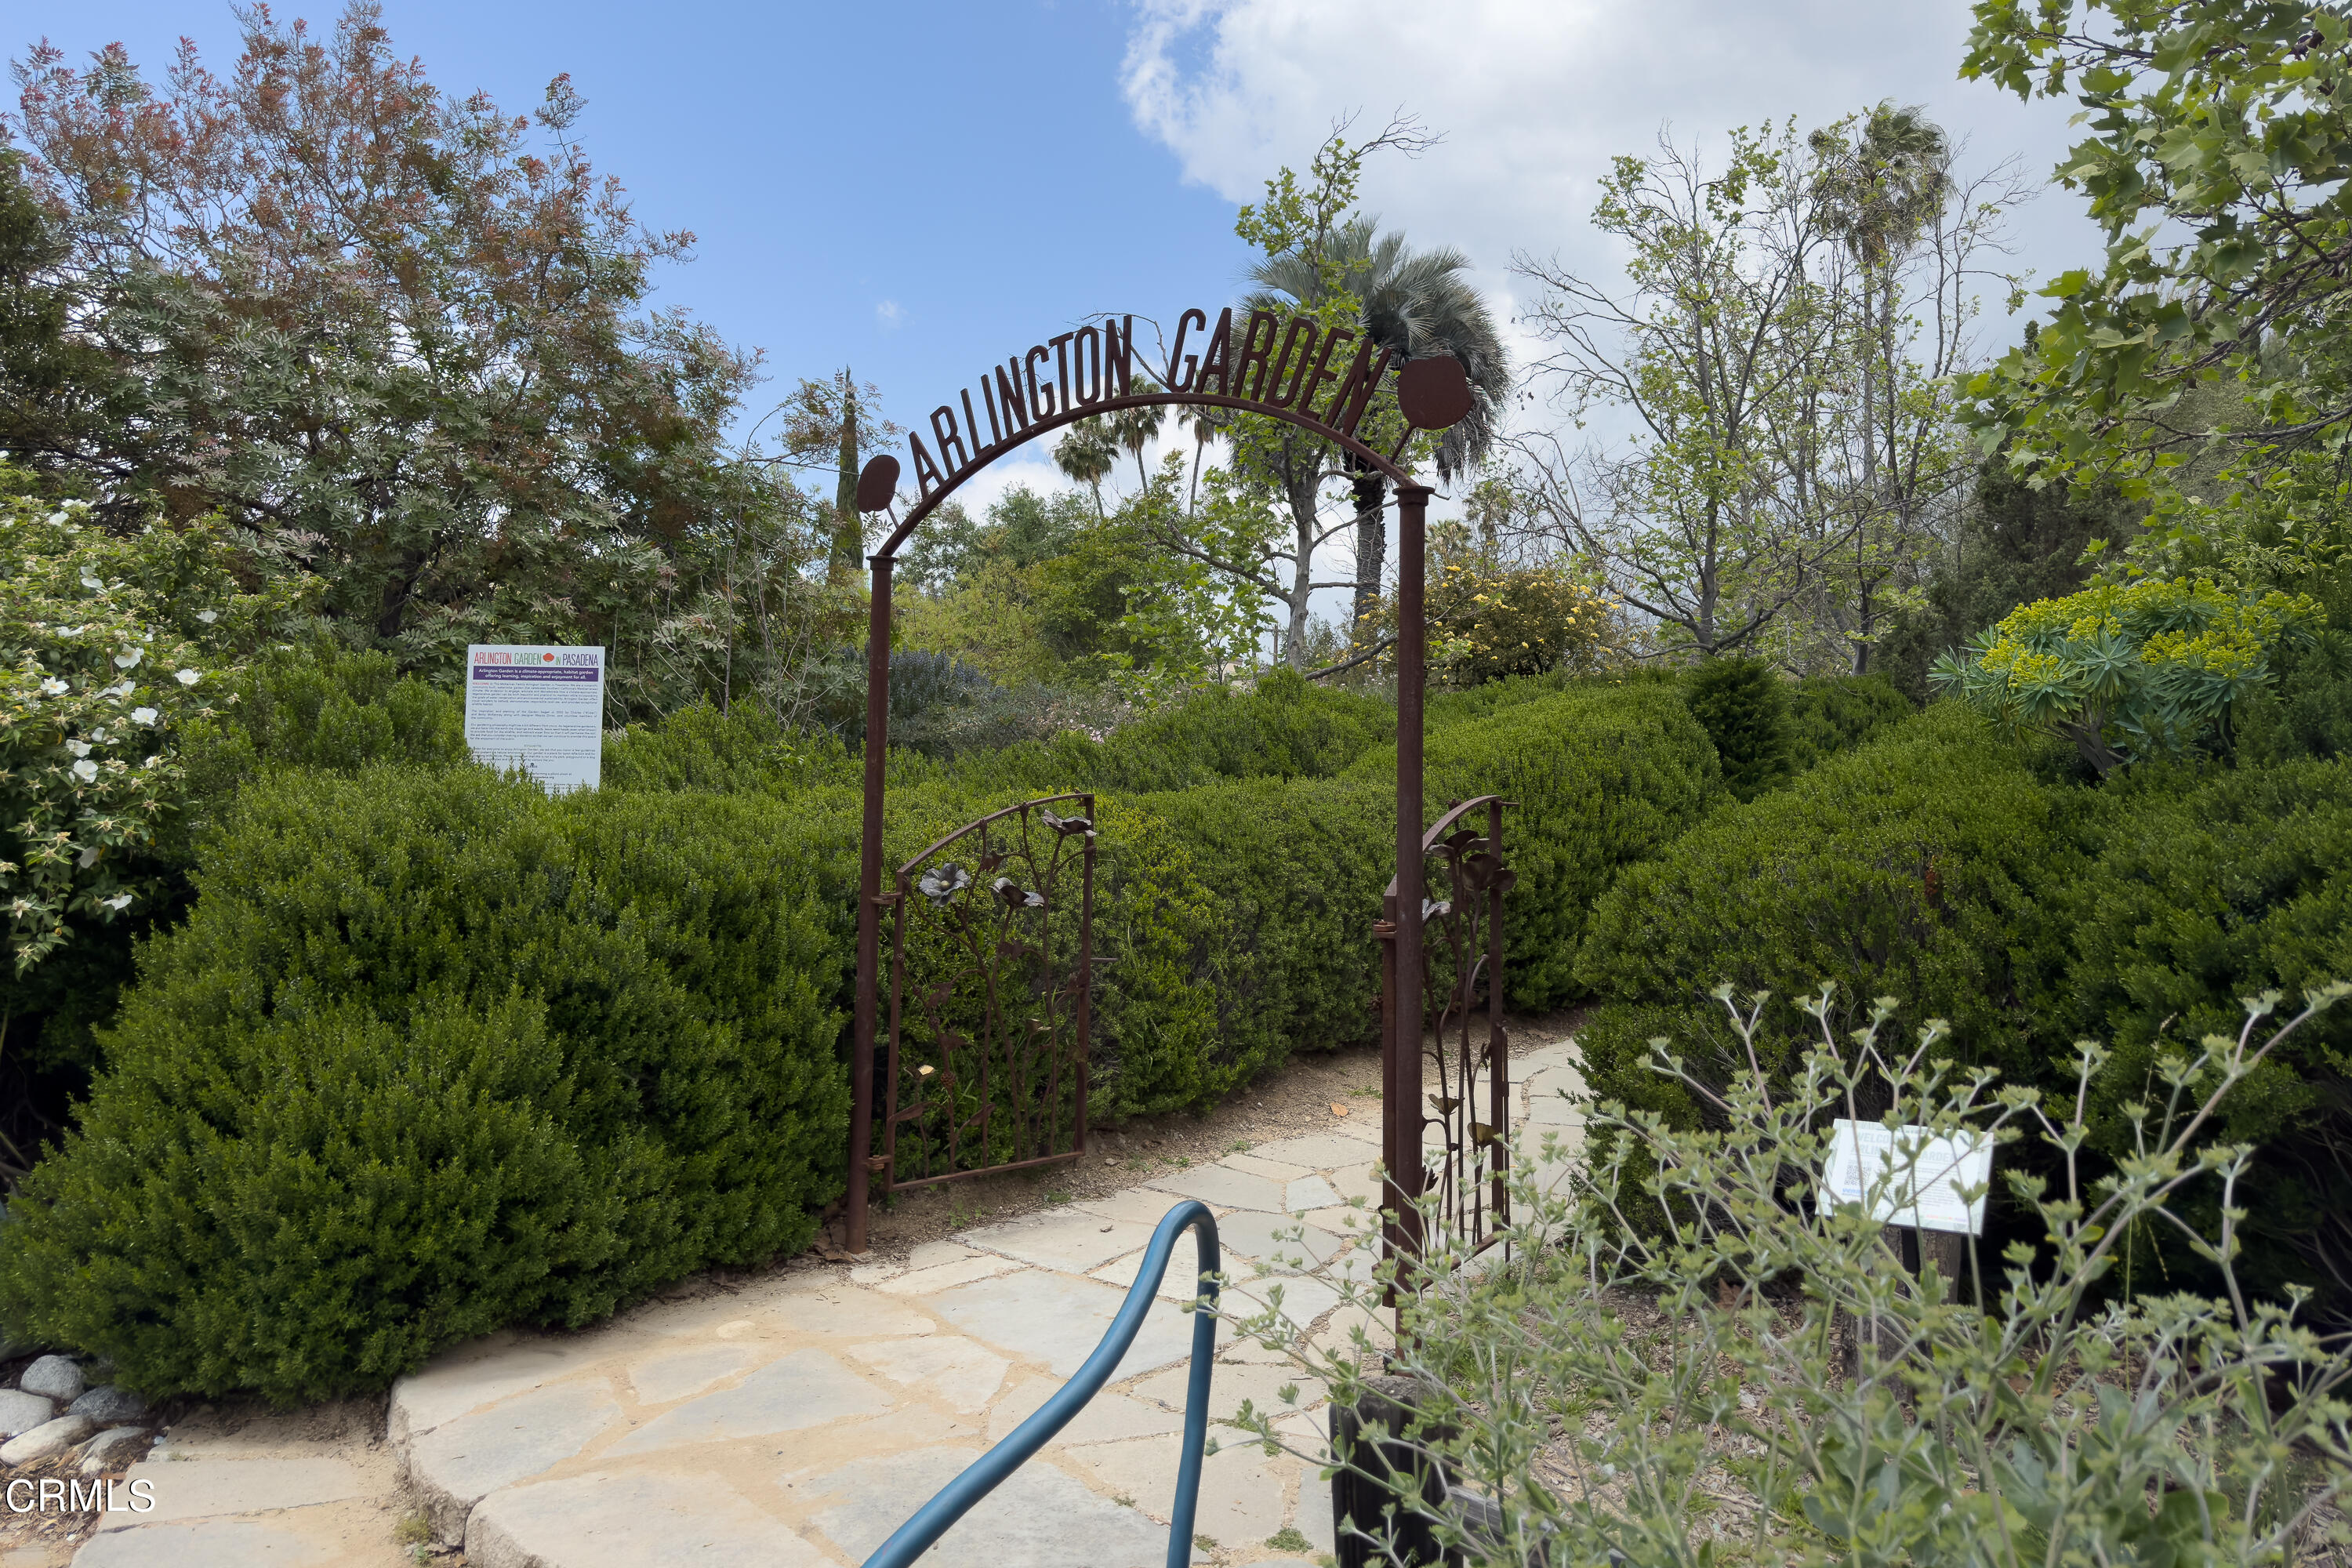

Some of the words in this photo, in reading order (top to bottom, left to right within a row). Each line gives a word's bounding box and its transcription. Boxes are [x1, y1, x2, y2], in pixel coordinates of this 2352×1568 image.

[909, 315, 1133, 502] ARLINGTON
[1167, 307, 1392, 437] GARDEN
[474, 652, 512, 665] ARLINGTON
[514, 652, 542, 666] GARDEN
[555, 656, 561, 666] IN
[562, 653, 598, 666] PASADENA
